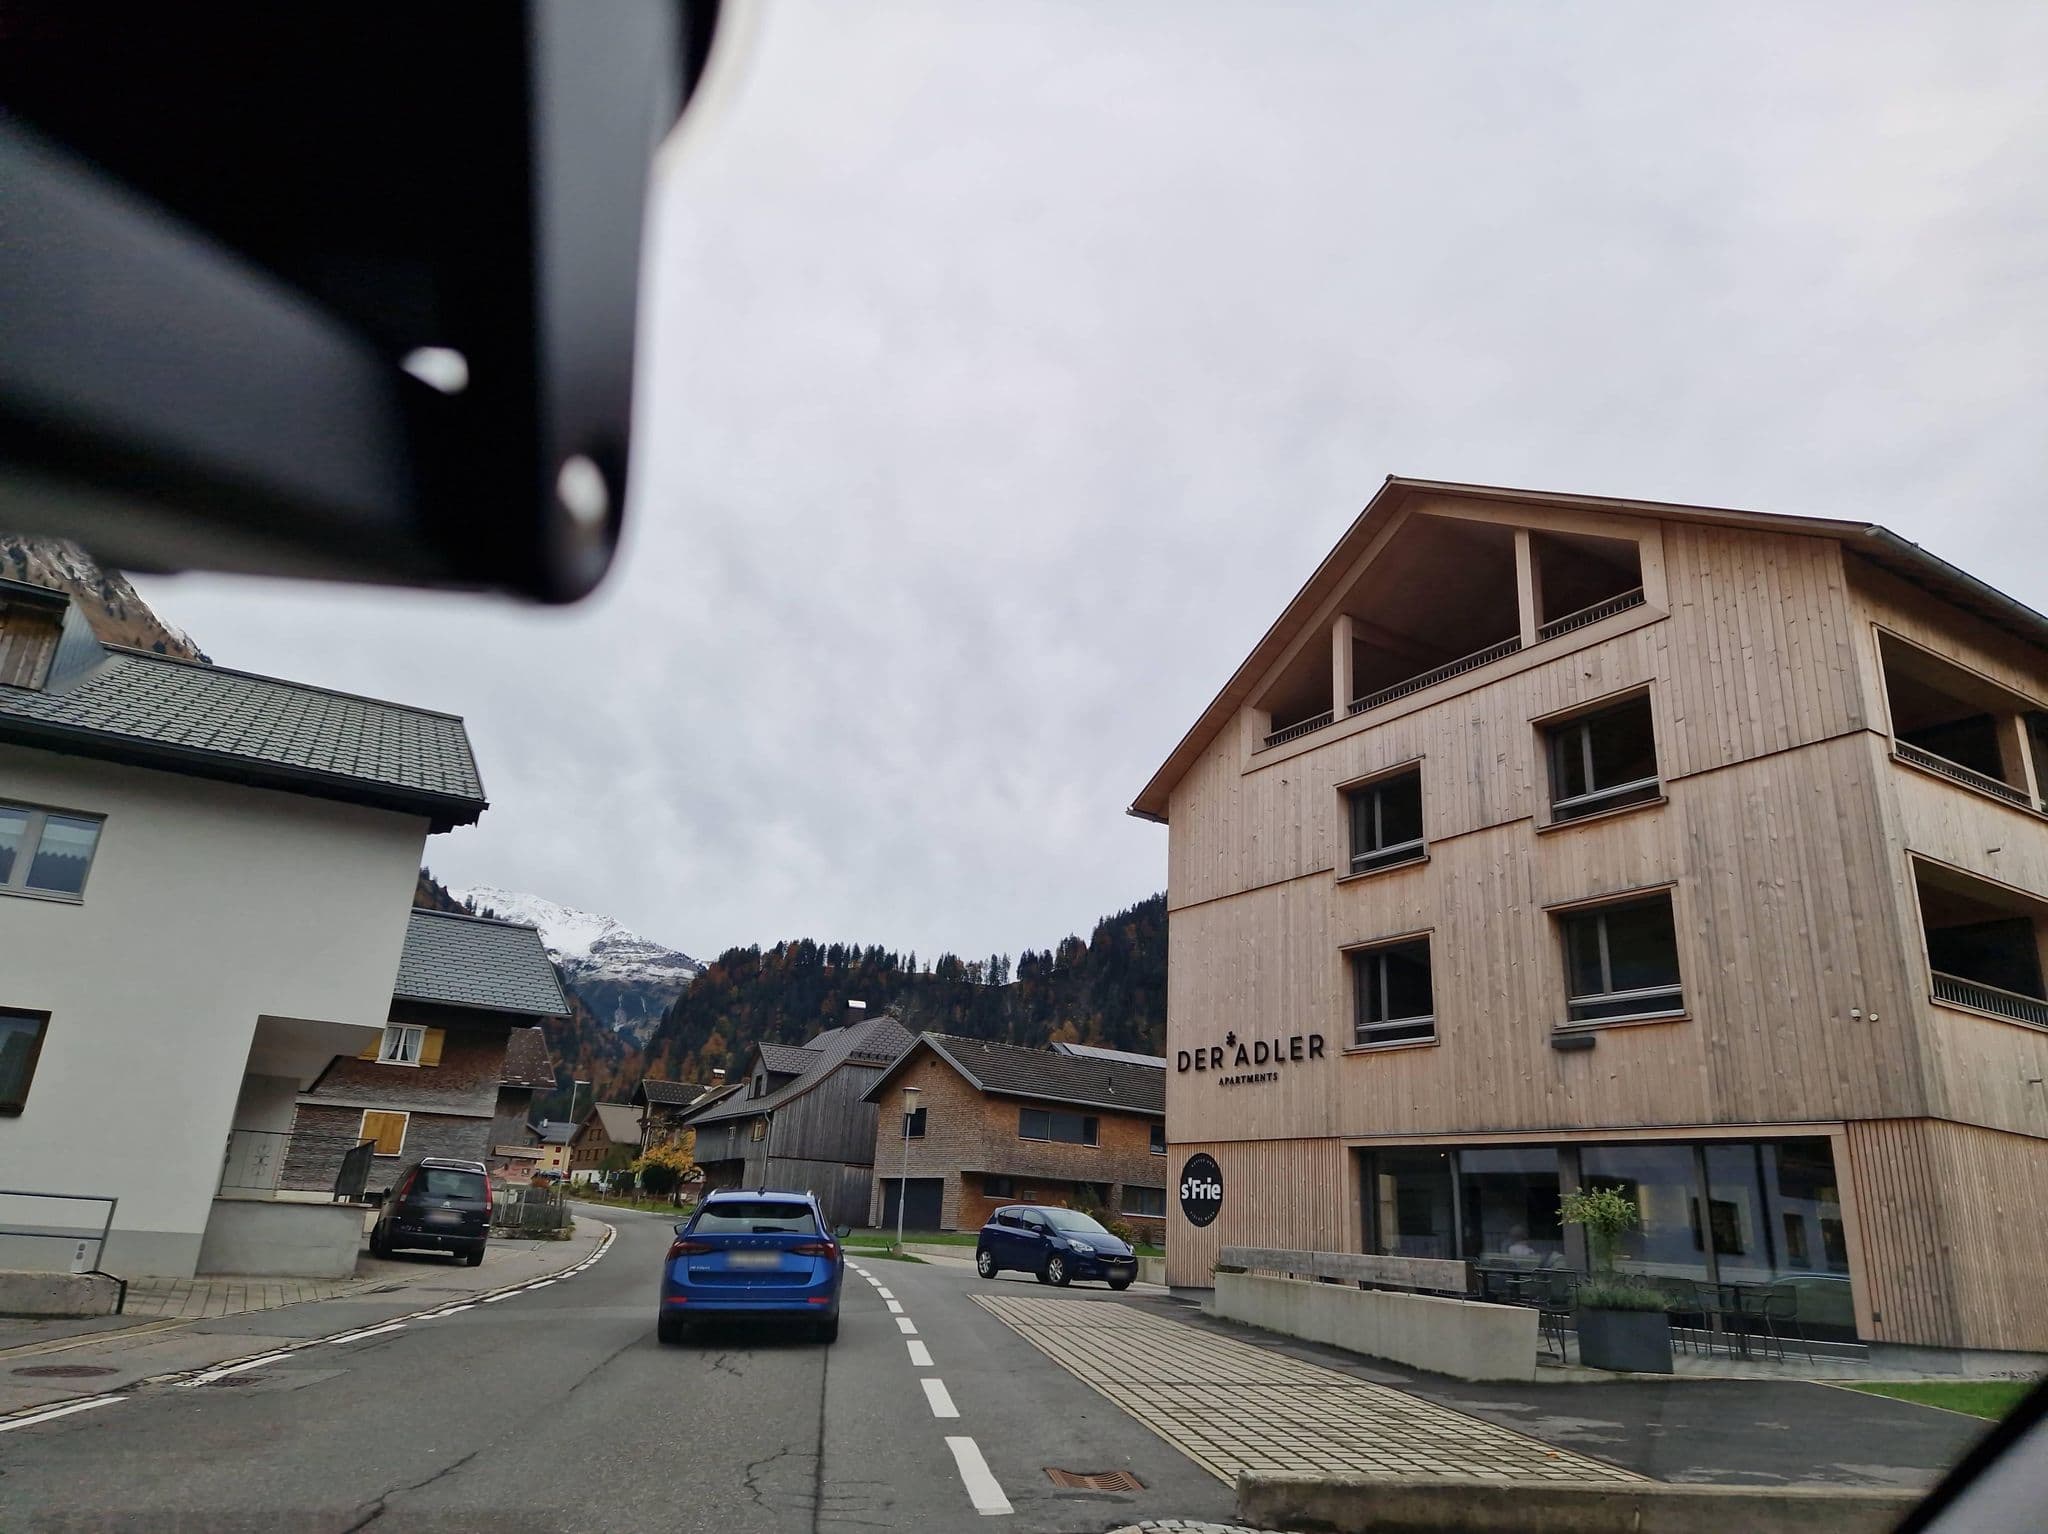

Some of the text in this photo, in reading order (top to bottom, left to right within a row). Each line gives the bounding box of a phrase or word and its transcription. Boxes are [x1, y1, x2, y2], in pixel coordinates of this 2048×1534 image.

[1177, 1034, 1325, 1073] DER ADLER
[1218, 1072, 1279, 1086] APARTMENTS
[1181, 1177, 1222, 1200] s'Frie
